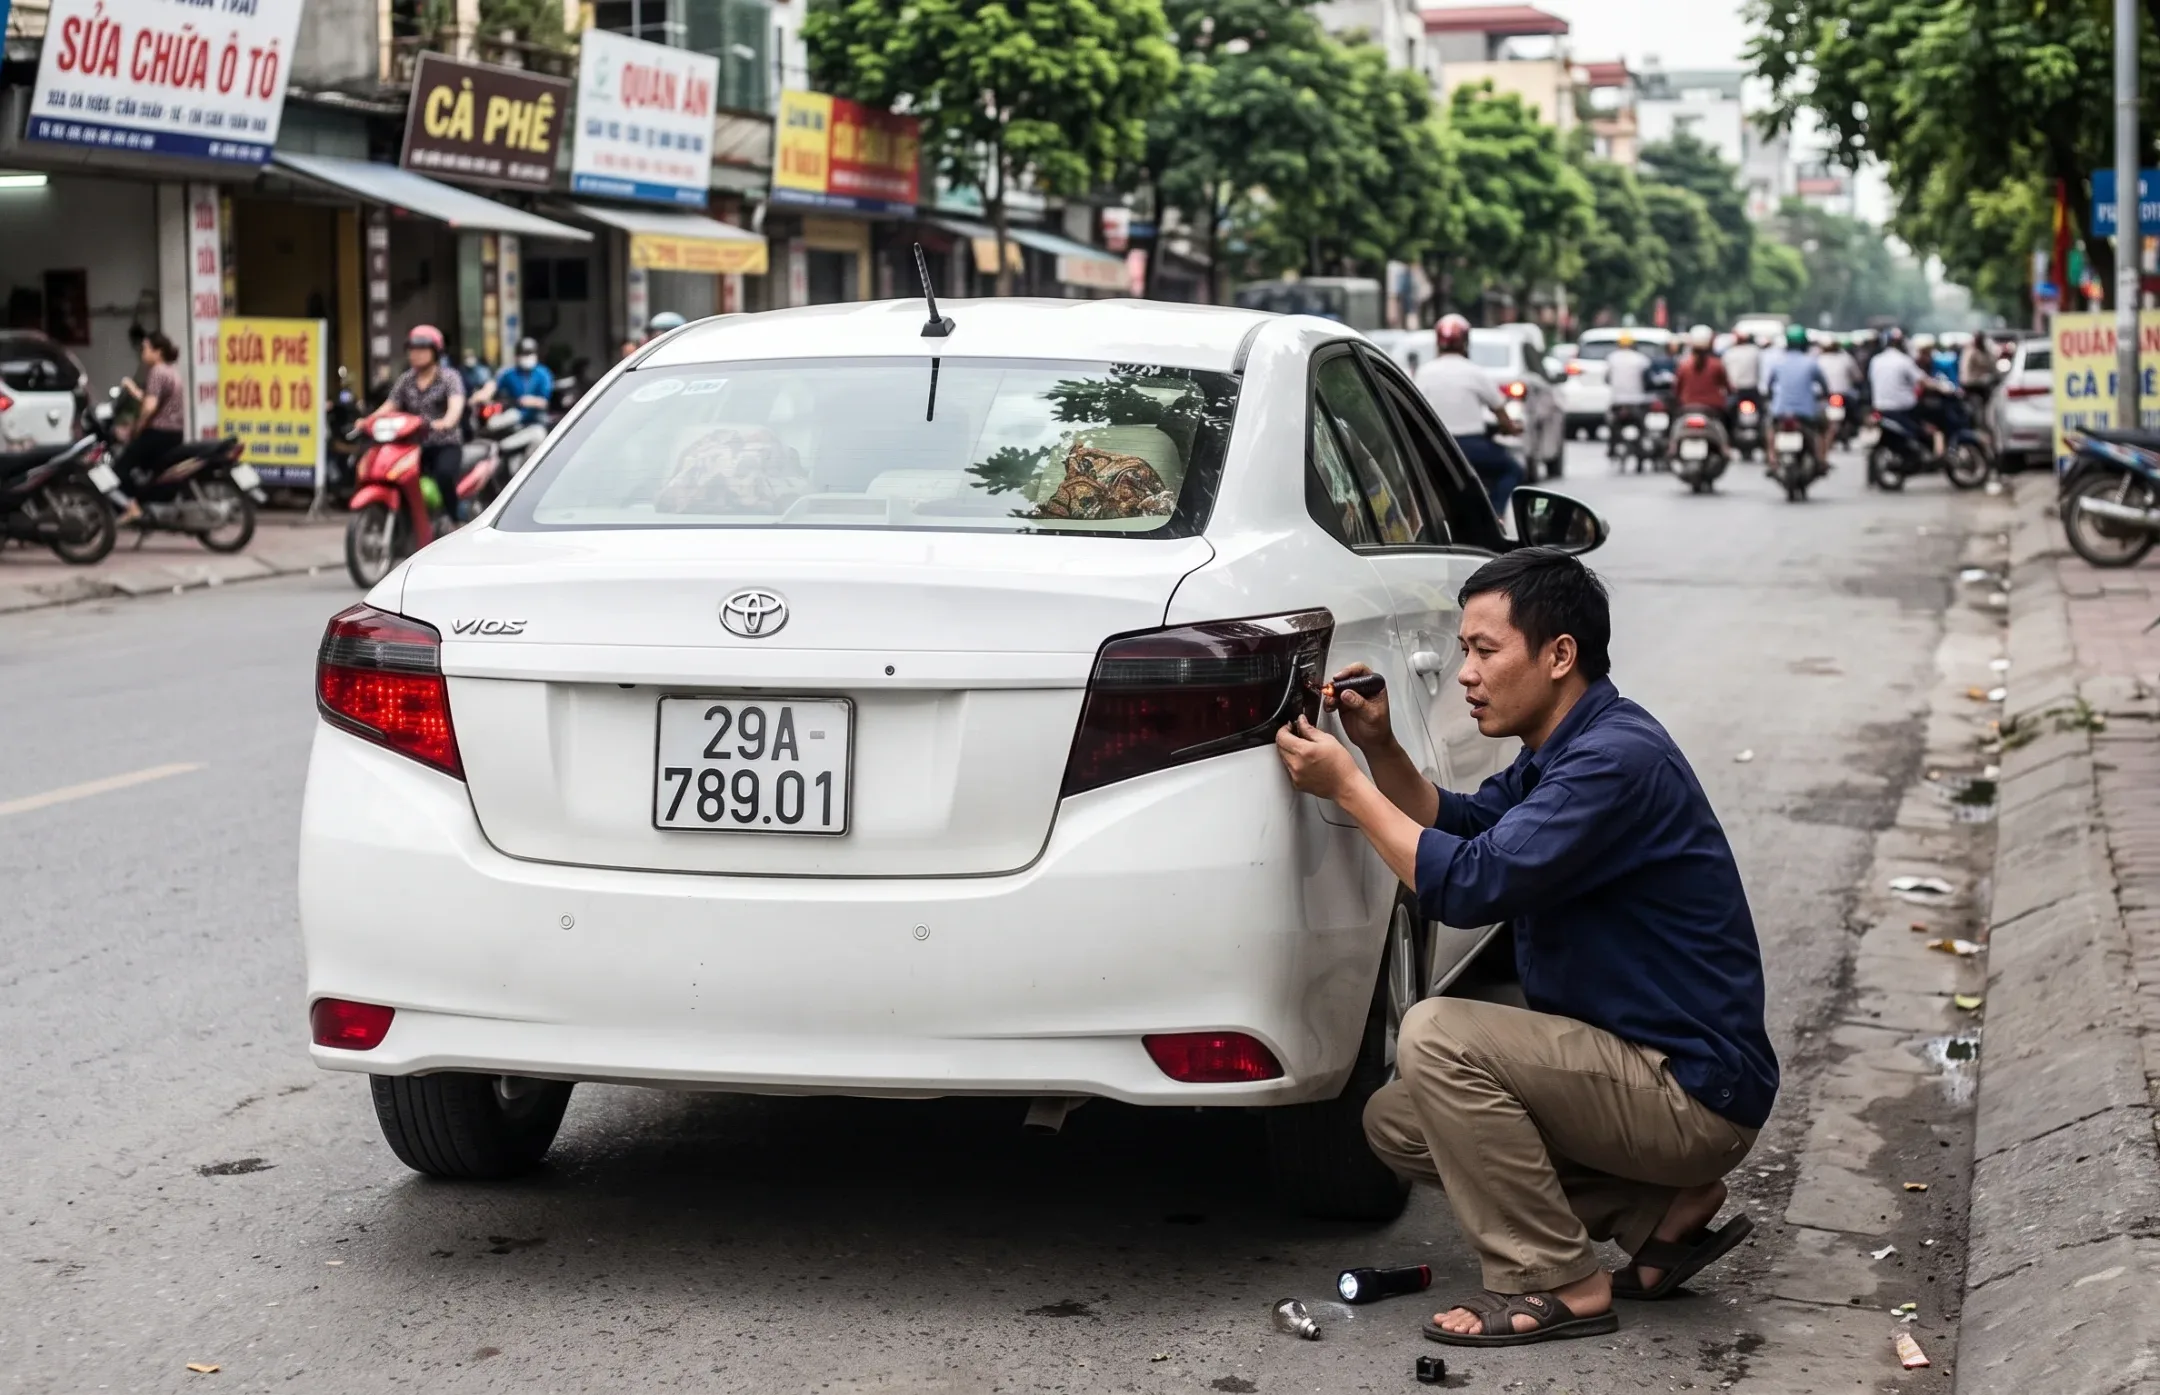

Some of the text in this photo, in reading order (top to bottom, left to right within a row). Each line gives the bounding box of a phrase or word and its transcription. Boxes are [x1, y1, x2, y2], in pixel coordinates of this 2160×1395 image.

[56, 2, 123, 78] SỬA
[130, 23, 209, 90] CHỮA
[423, 77, 475, 142] CÀ
[482, 91, 556, 153] PHÊ
[451, 617, 528, 635] VIOS
[663, 767, 833, 827] 789.01
